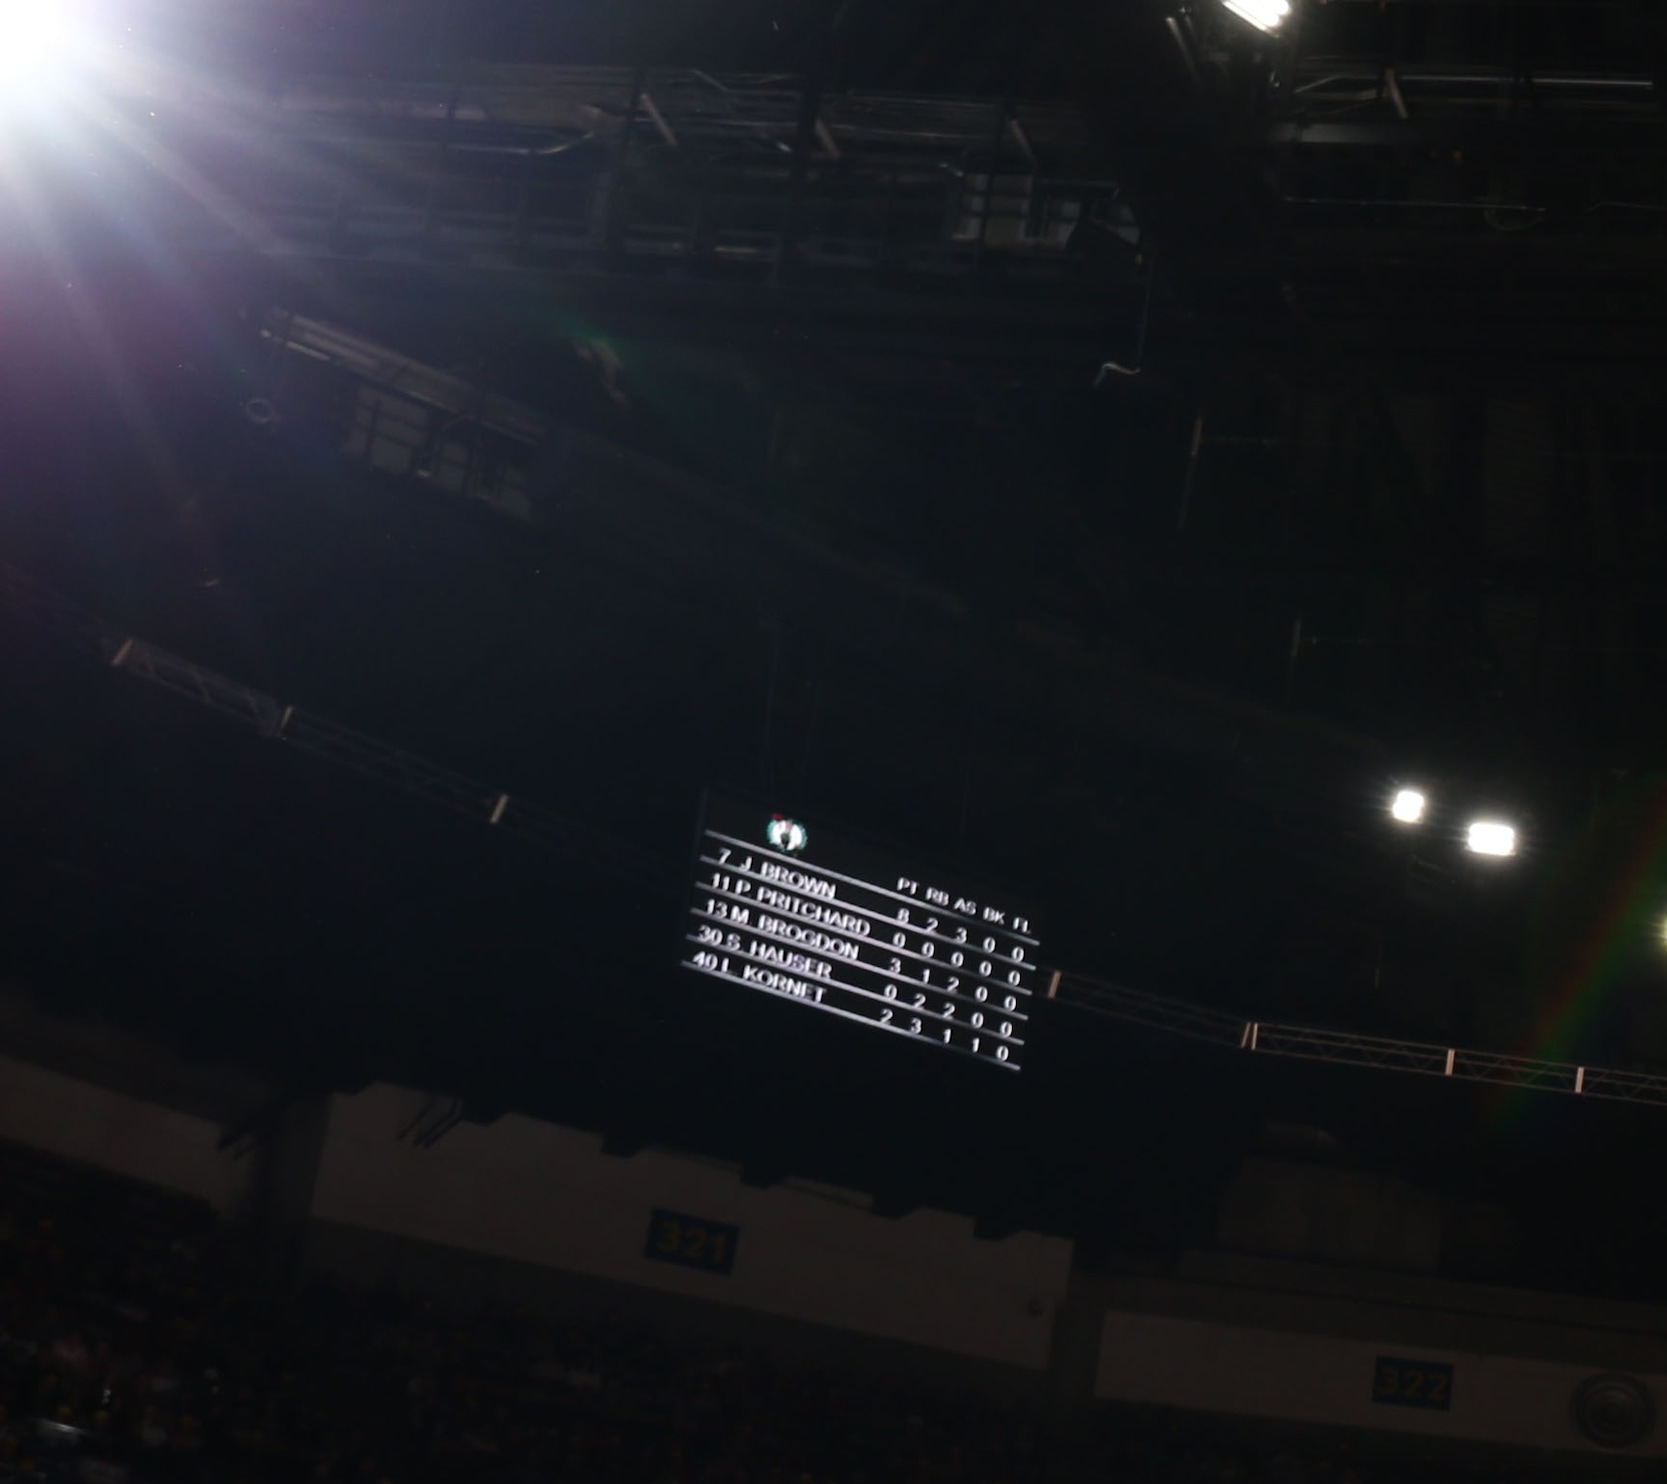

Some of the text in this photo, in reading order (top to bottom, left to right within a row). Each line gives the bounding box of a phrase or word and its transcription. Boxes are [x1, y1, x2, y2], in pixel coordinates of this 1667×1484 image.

[706, 899, 728, 917] 13
[758, 914, 859, 960] BROGDON
[889, 957, 901, 973] 3
[947, 977, 959, 993] 2
[975, 986, 987, 1002] 0
[1004, 996, 1017, 1011] 0
[712, 873, 730, 891] 11
[757, 886, 871, 937] PRITCHARD
[893, 932, 906, 948] 0
[922, 942, 934, 957] 0
[951, 952, 964, 967] 0
[979, 961, 992, 977] 0
[1008, 970, 1020, 986] 0
[760, 861, 836, 898] BROWN
[926, 917, 938, 932] 2
[955, 927, 967, 943] 3
[983, 937, 996, 953] 0
[1012, 946, 1024, 962] 0
[954, 898, 976, 915] AS
[983, 907, 1005, 924] BK
[743, 964, 827, 1003] KORNET
[880, 1008, 893, 1024] 2
[910, 1017, 922, 1034] 3
[996, 1045, 1009, 1061] 0
[751, 940, 833, 979] HAUSER
[884, 984, 897, 1000] 0
[913, 993, 926, 1009] 2
[942, 1003, 955, 1019] 2
[971, 1012, 984, 1028] 0
[1000, 1021, 1013, 1037] 0
